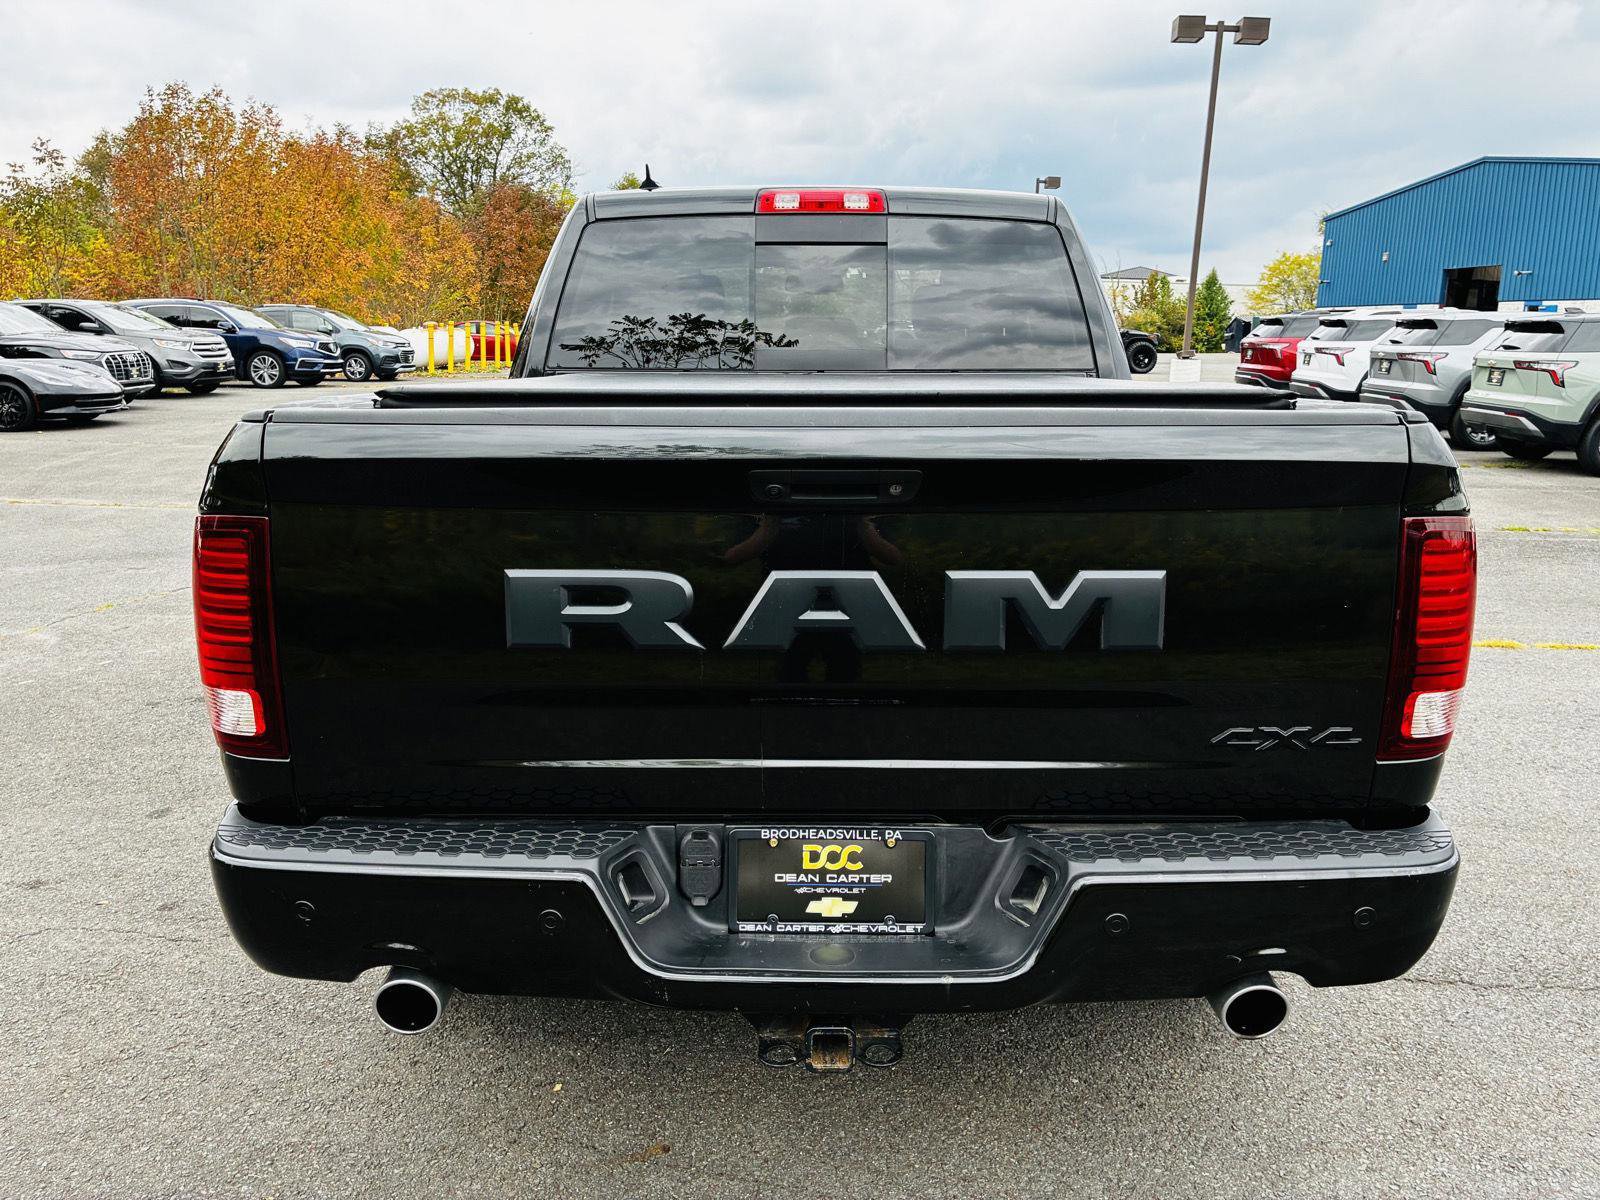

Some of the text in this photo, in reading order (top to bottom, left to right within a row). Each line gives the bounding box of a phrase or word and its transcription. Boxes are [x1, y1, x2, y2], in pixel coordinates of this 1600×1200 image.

[504, 569, 1167, 650] RAM
[761, 829, 902, 840] BRODHEADSVILLE, PA
[774, 873, 893, 883] DEAN CARTER
[739, 924, 924, 933] DEAN CARTER CHEVROLET
